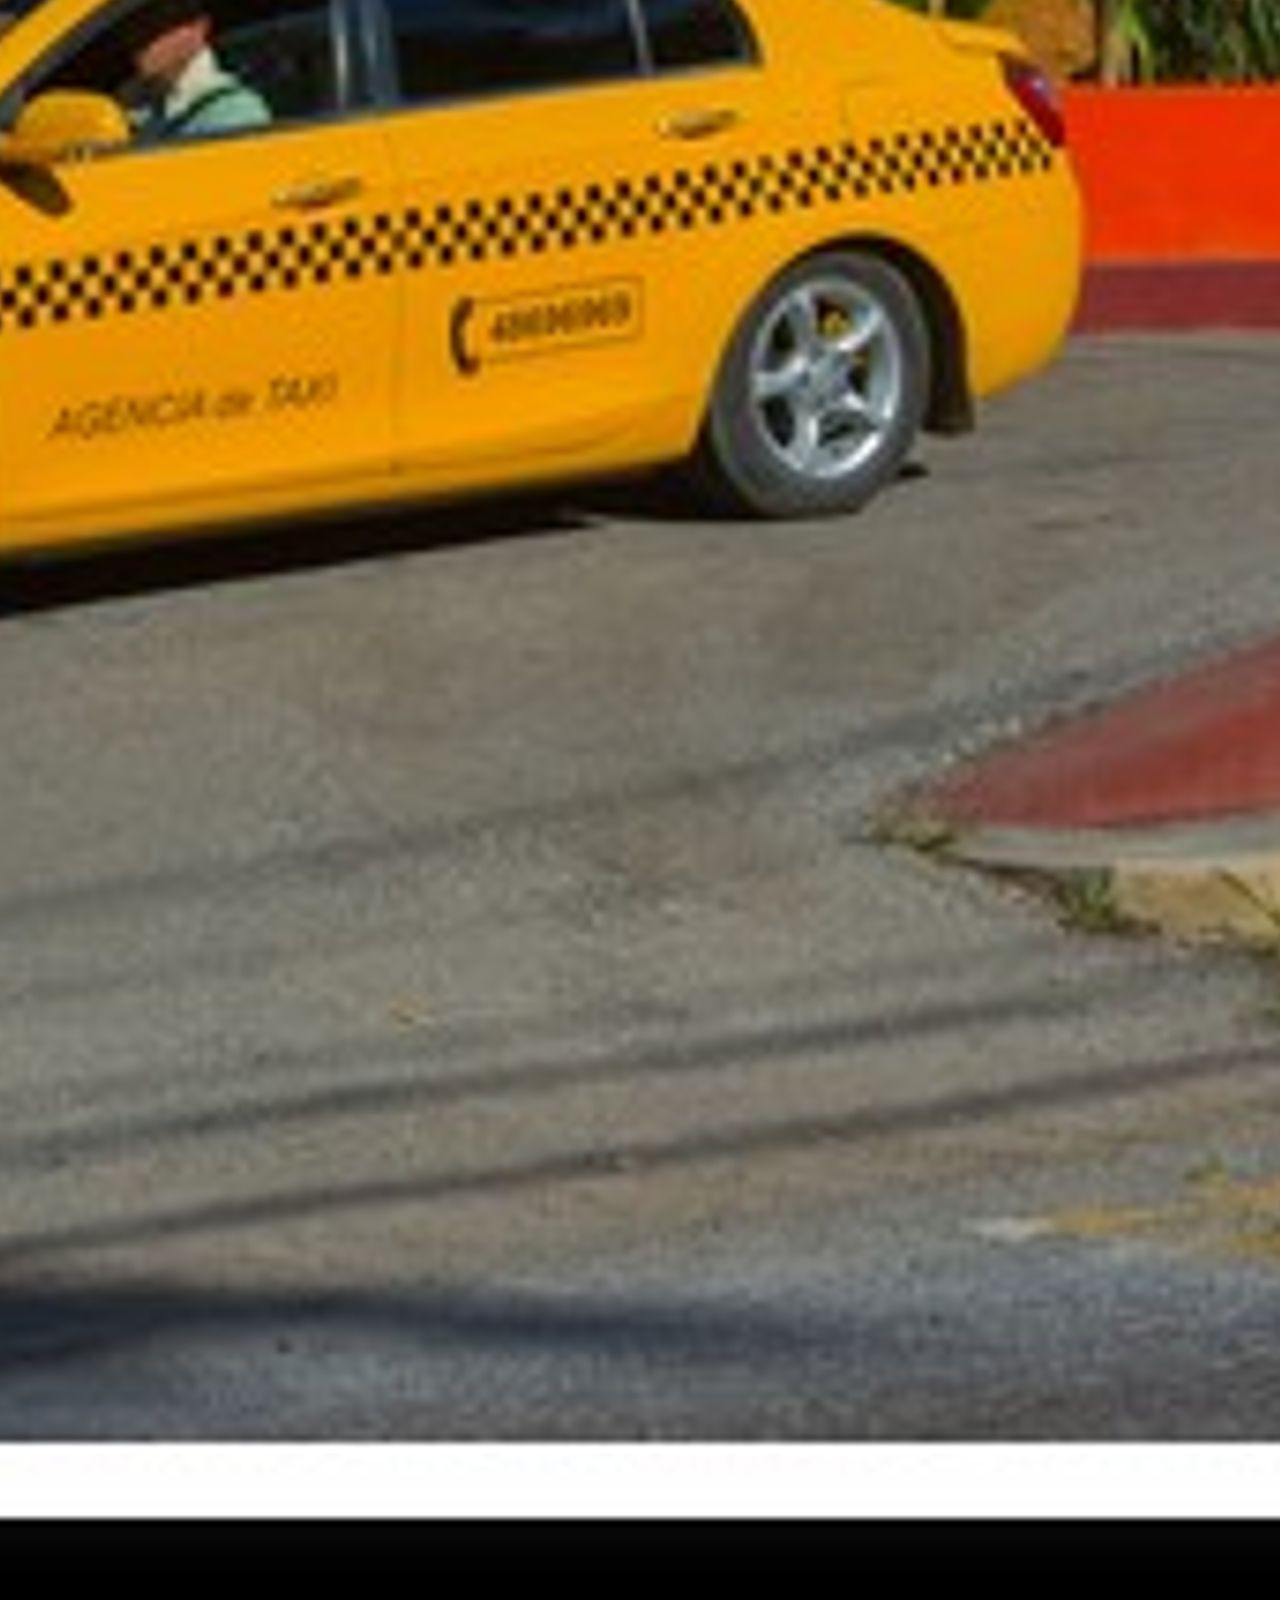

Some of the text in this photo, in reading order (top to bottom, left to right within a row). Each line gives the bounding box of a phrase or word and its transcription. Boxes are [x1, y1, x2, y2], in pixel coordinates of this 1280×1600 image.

[44, 372, 339, 441] AGENCIA de TAXI
